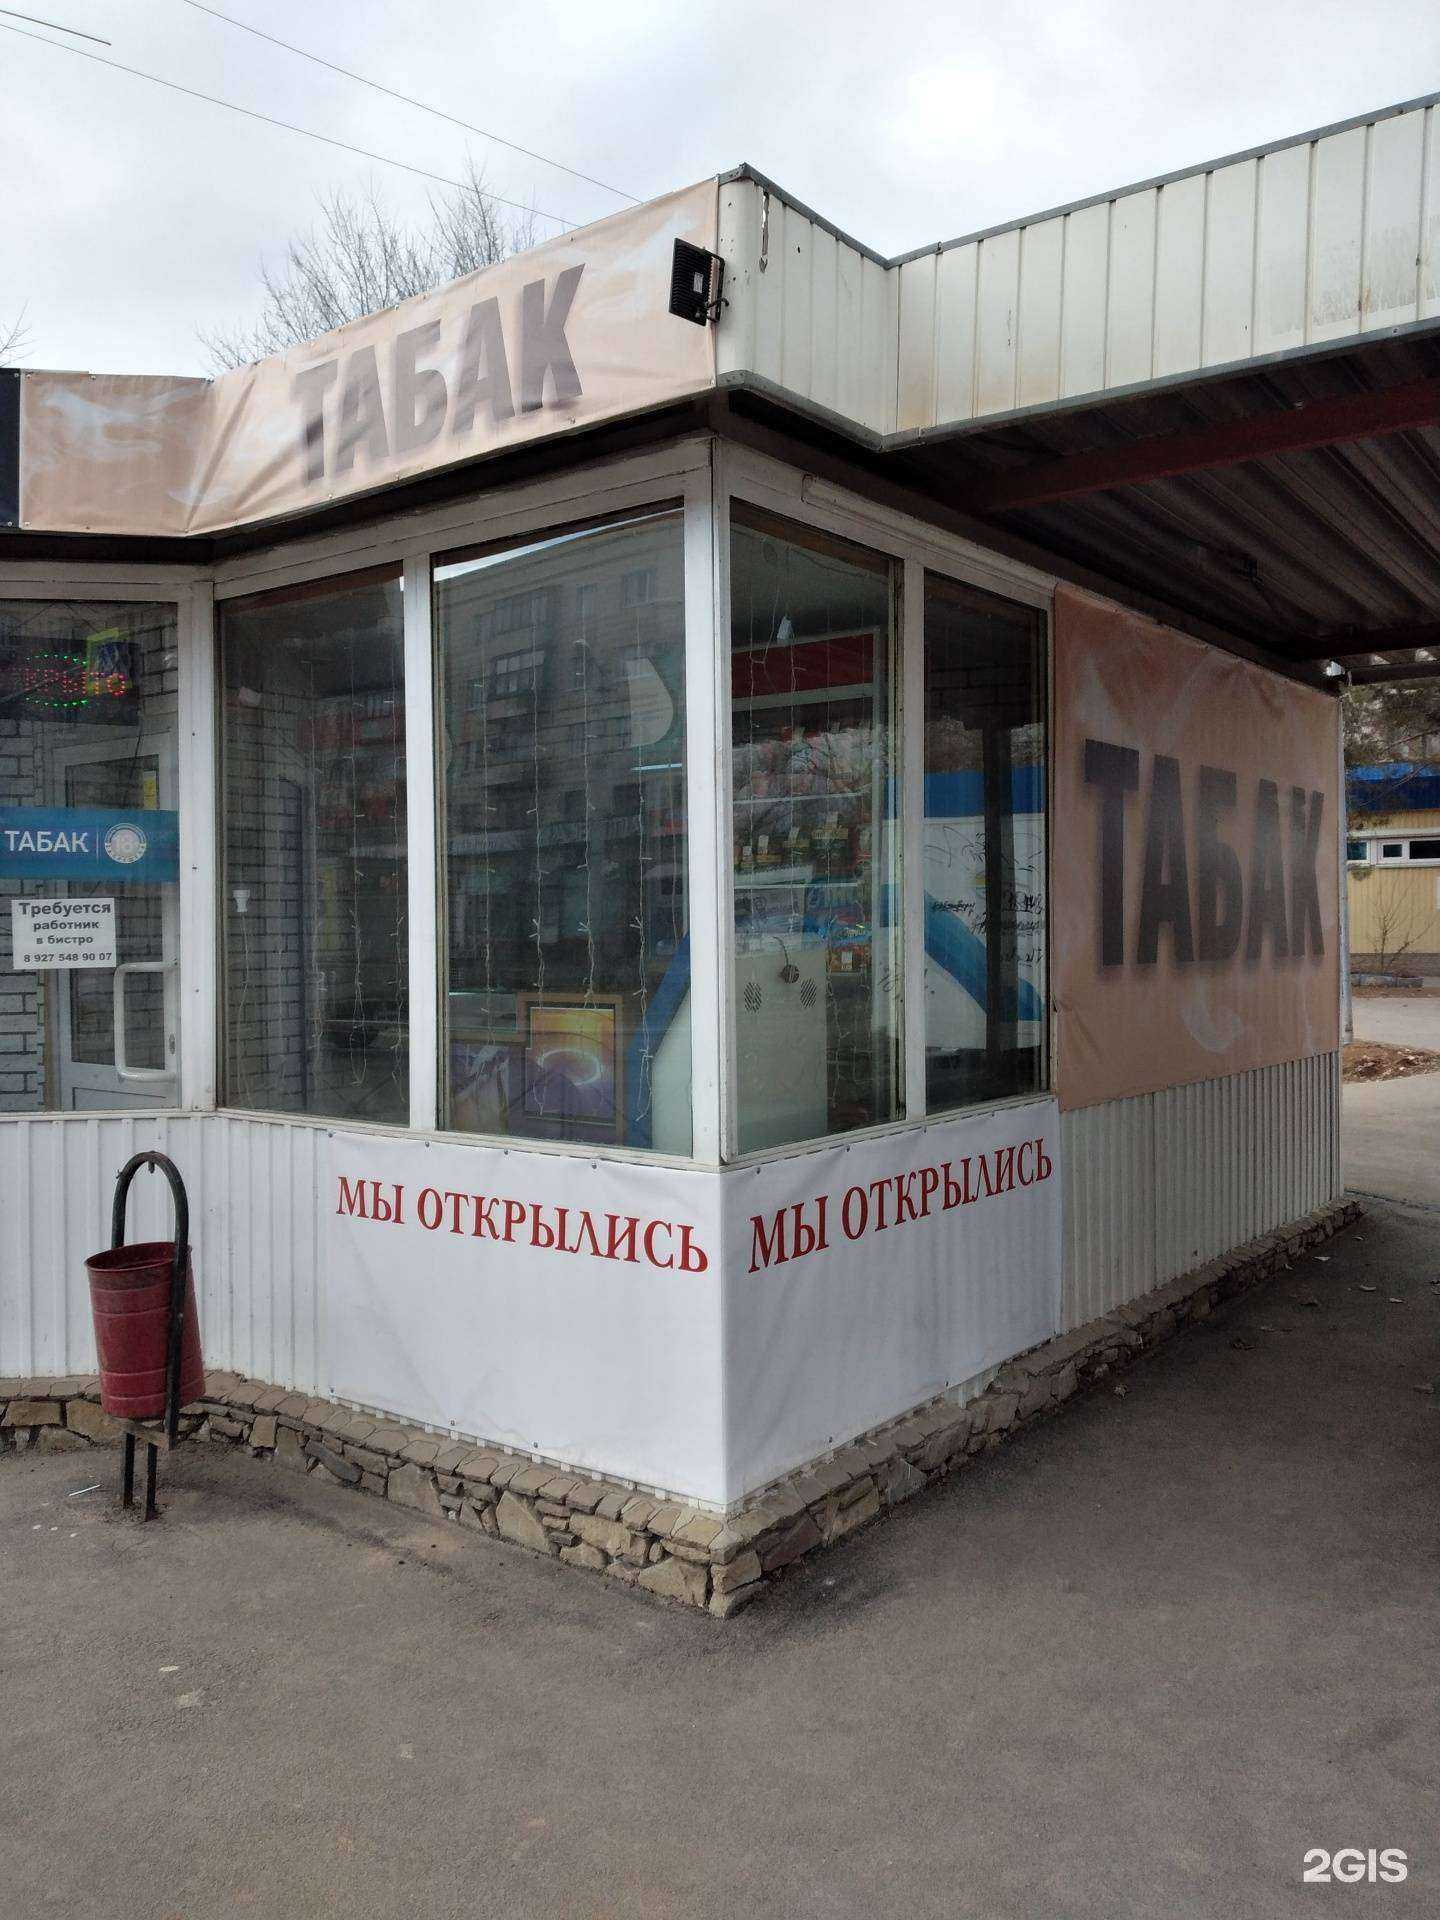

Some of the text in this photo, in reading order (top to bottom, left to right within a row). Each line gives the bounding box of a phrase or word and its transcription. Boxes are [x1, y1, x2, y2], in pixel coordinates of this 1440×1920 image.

[290, 263, 586, 481] ТАБАК
[4, 830, 89, 853] ТАБАК
[1084, 738, 1325, 967] ТАБАК
[19, 902, 112, 918] Требуется
[33, 920, 100, 932] работник
[36, 935, 94, 946] в бистро
[23, 952, 112, 963] 8 927 548 90 07
[748, 1137, 1053, 1274] МЫ ОТКРЫЛИСЬ
[335, 1175, 709, 1274] МЫ ОТКРЫЛИСЬ
